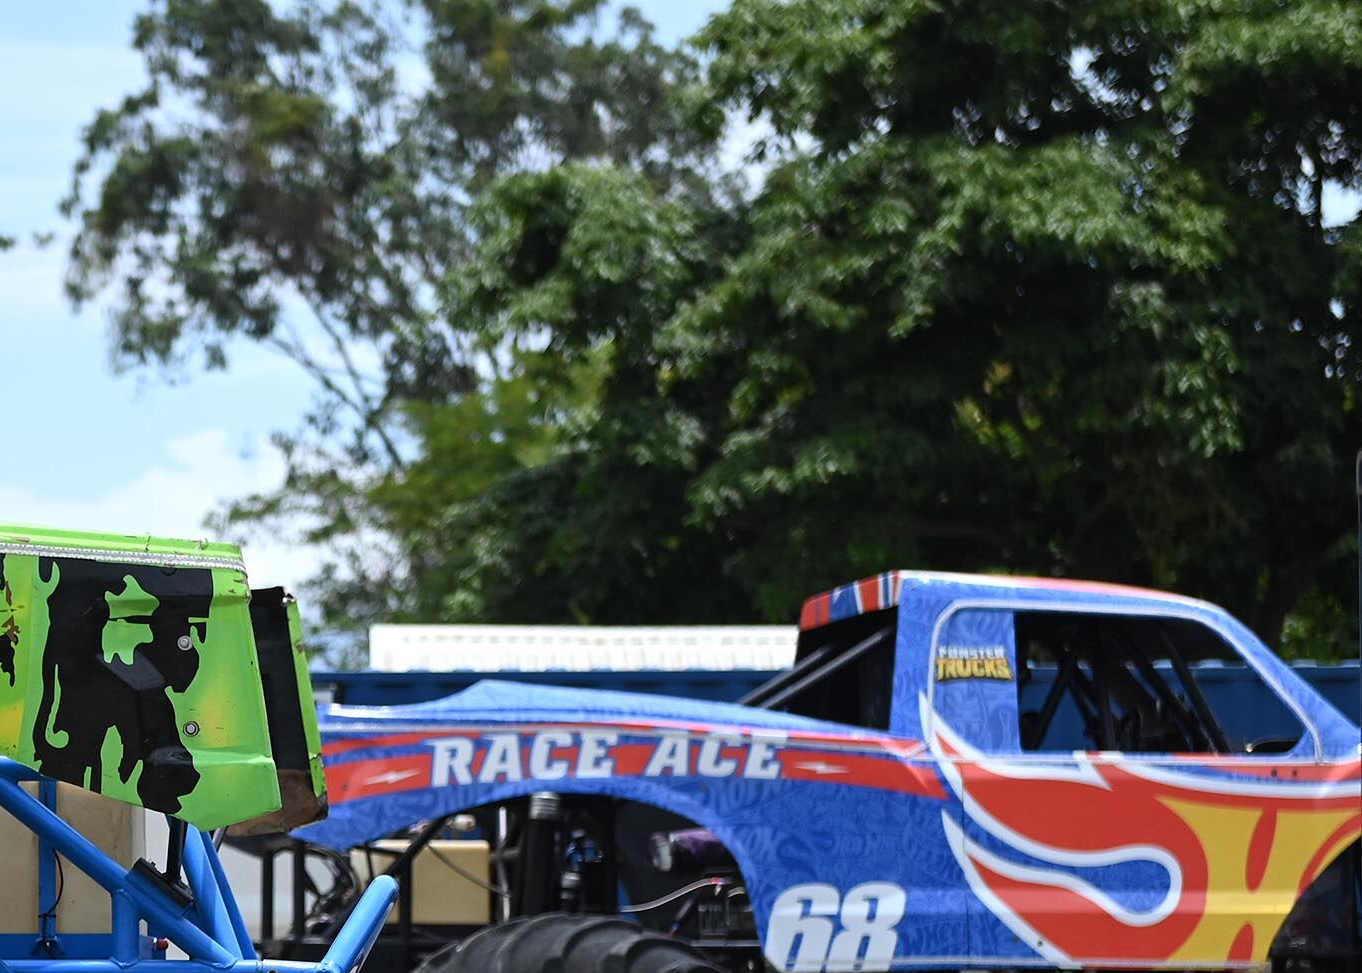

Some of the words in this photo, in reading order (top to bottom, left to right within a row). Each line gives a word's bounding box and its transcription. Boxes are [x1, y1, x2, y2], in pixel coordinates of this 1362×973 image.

[937, 658, 1013, 681] TRUCKS
[423, 729, 618, 788] RACE
[645, 729, 789, 780] ACE
[765, 881, 907, 973] 68
